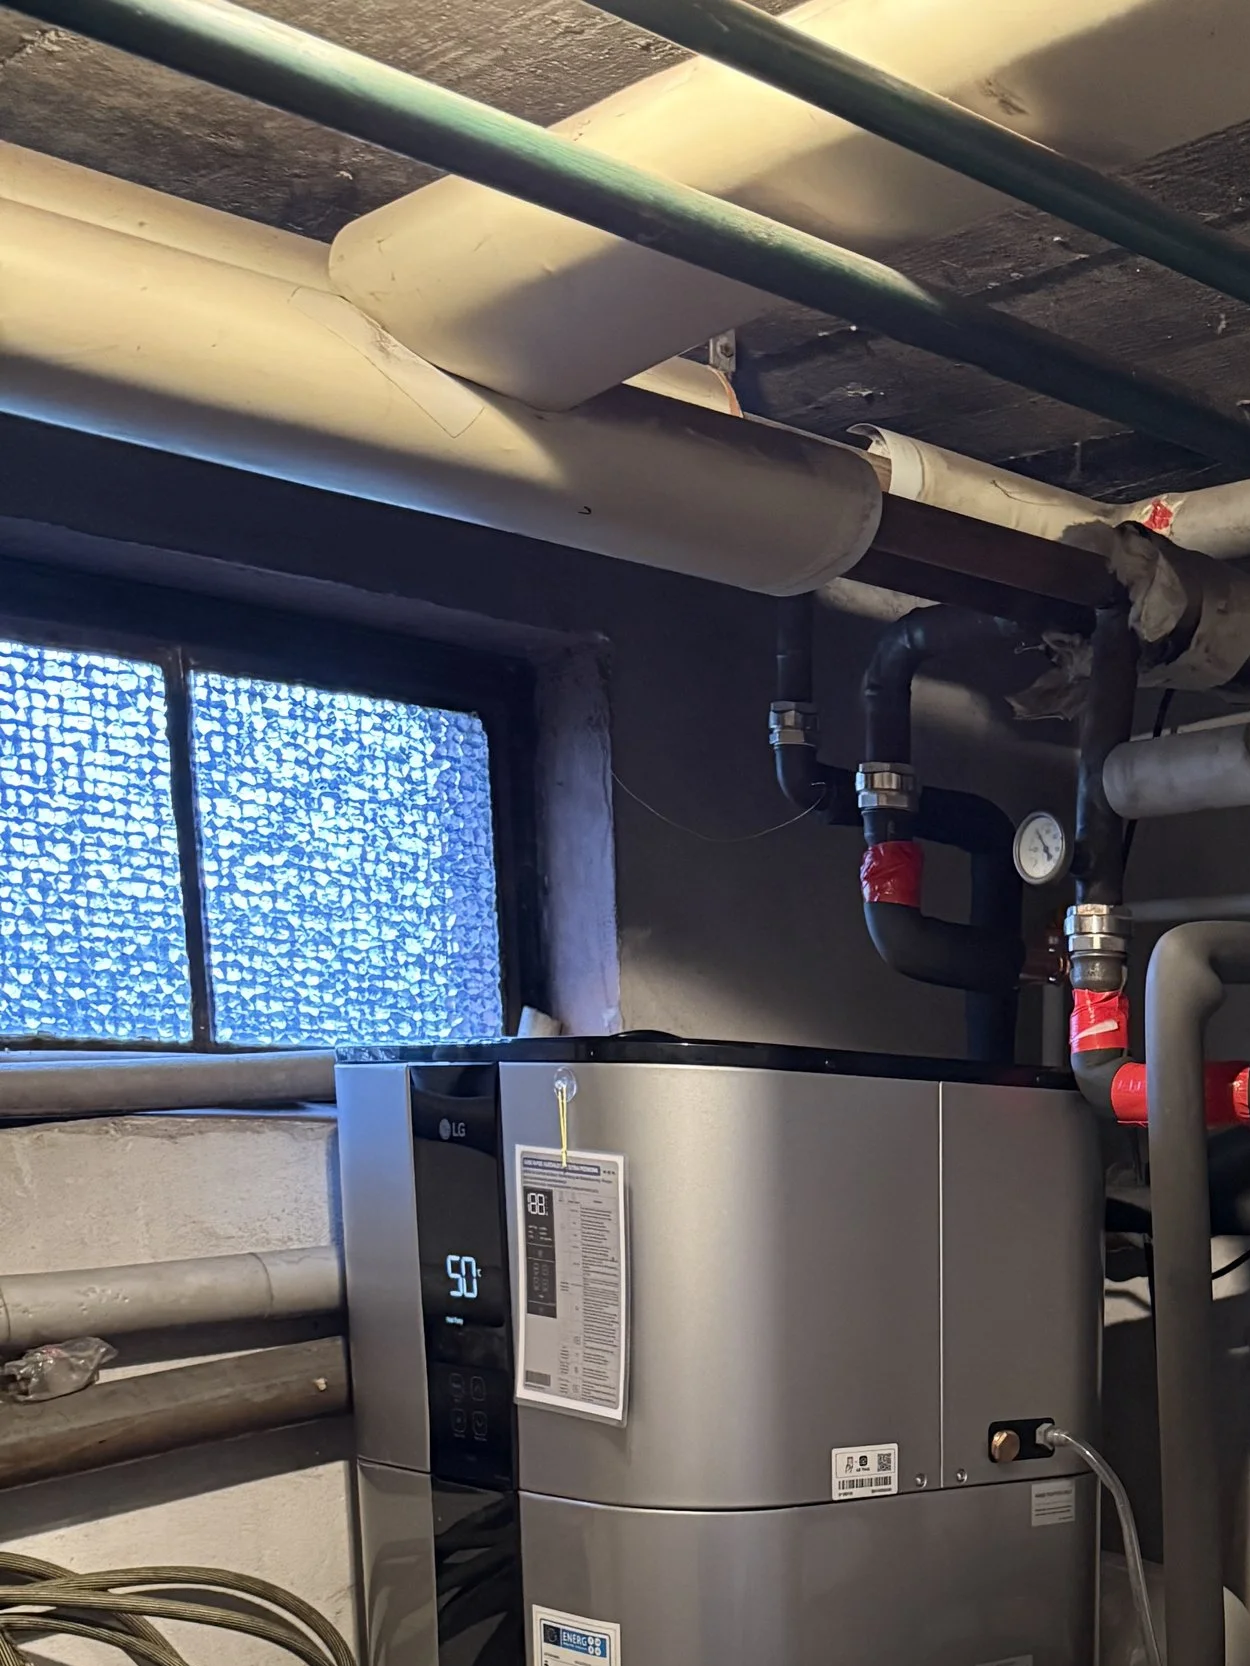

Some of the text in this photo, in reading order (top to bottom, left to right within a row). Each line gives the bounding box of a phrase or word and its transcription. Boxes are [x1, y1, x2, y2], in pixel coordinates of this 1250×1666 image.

[452, 1121, 466, 1137] LG
[446, 1254, 478, 1298] 50
[562, 1631, 587, 1646] ENERG
